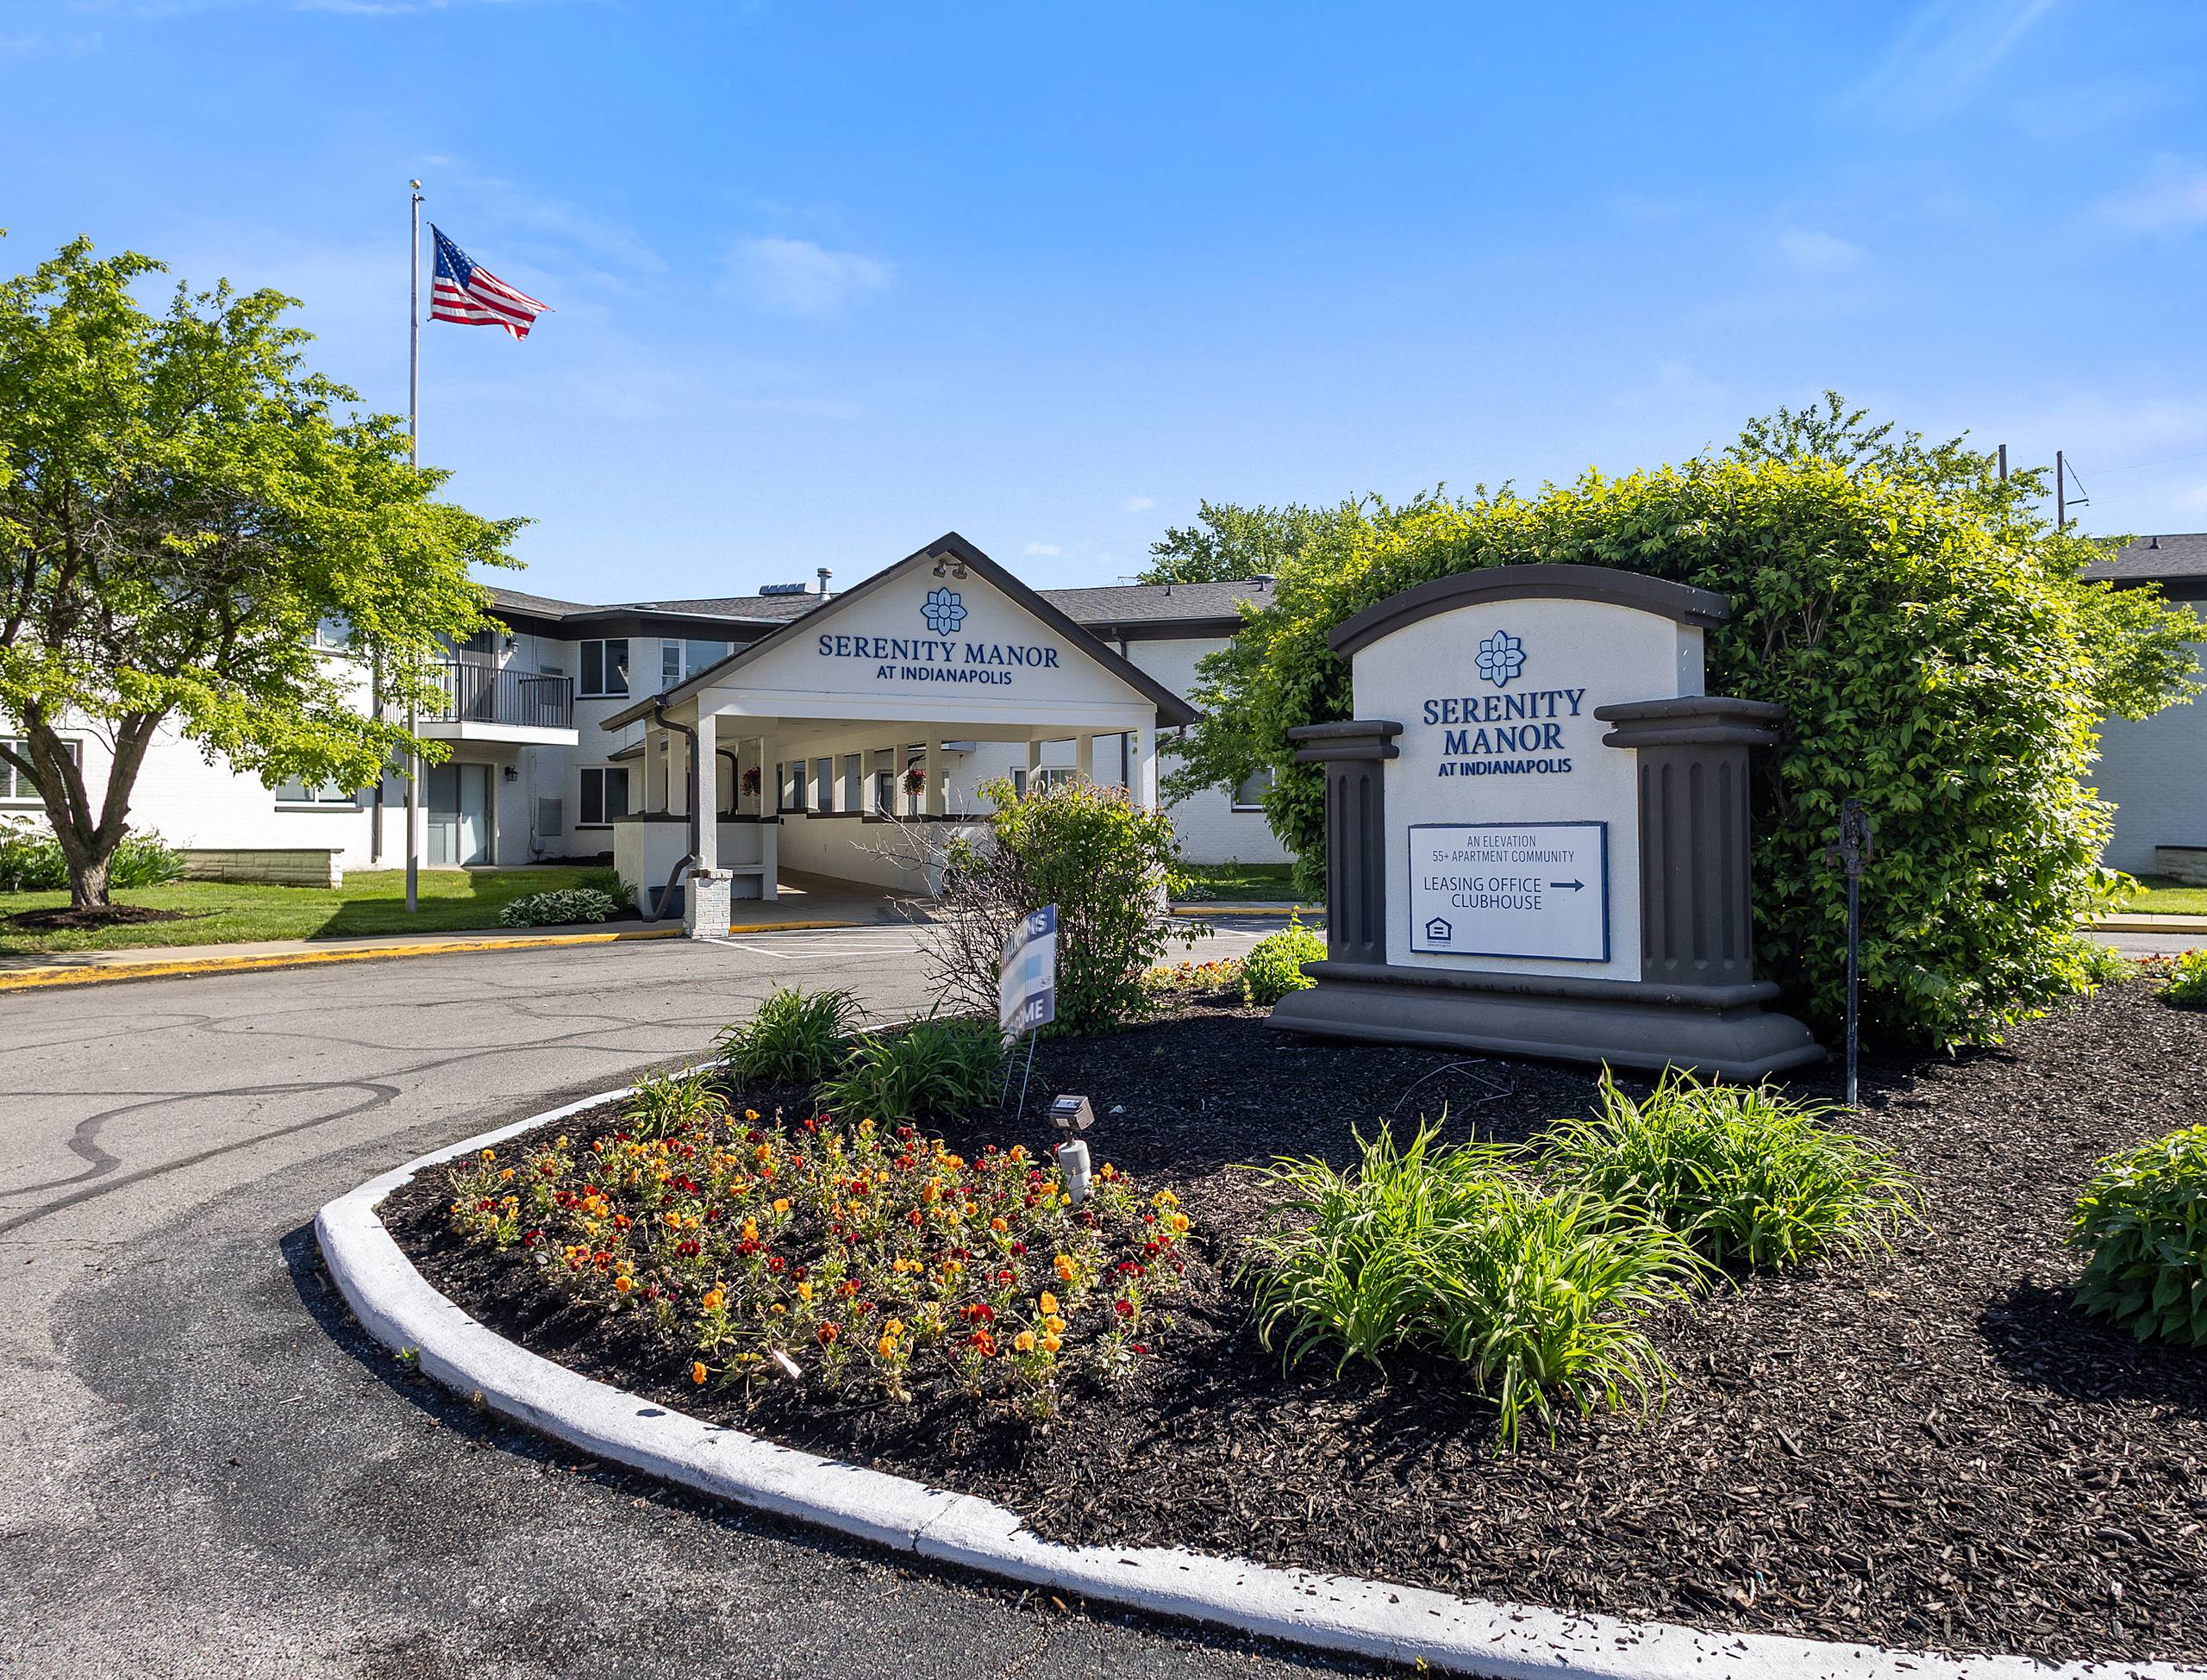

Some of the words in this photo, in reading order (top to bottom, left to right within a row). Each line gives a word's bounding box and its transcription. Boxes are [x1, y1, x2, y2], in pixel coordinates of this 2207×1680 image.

[819, 634, 956, 662] SERENITY
[964, 643, 1060, 668] MANOR
[877, 665, 897, 679] AT
[901, 666, 1012, 684] INDIANAPOLIS
[1423, 688, 1586, 725] SERENITY
[1443, 723, 1565, 755] MANOR
[1438, 762, 1457, 777] AT
[1460, 758, 1572, 776] INDIANAPOLIS
[1467, 836, 1480, 846] AN
[1484, 835, 1536, 847] ELEVATION
[1433, 851, 1449, 862] 55+
[1452, 851, 1509, 863] APARTMENT
[1511, 851, 1574, 863] COMMUNITY
[1424, 877, 1484, 891] LEASING
[1489, 877, 1542, 892] OFFICE
[1452, 894, 1542, 910] CLUBHOUSE
